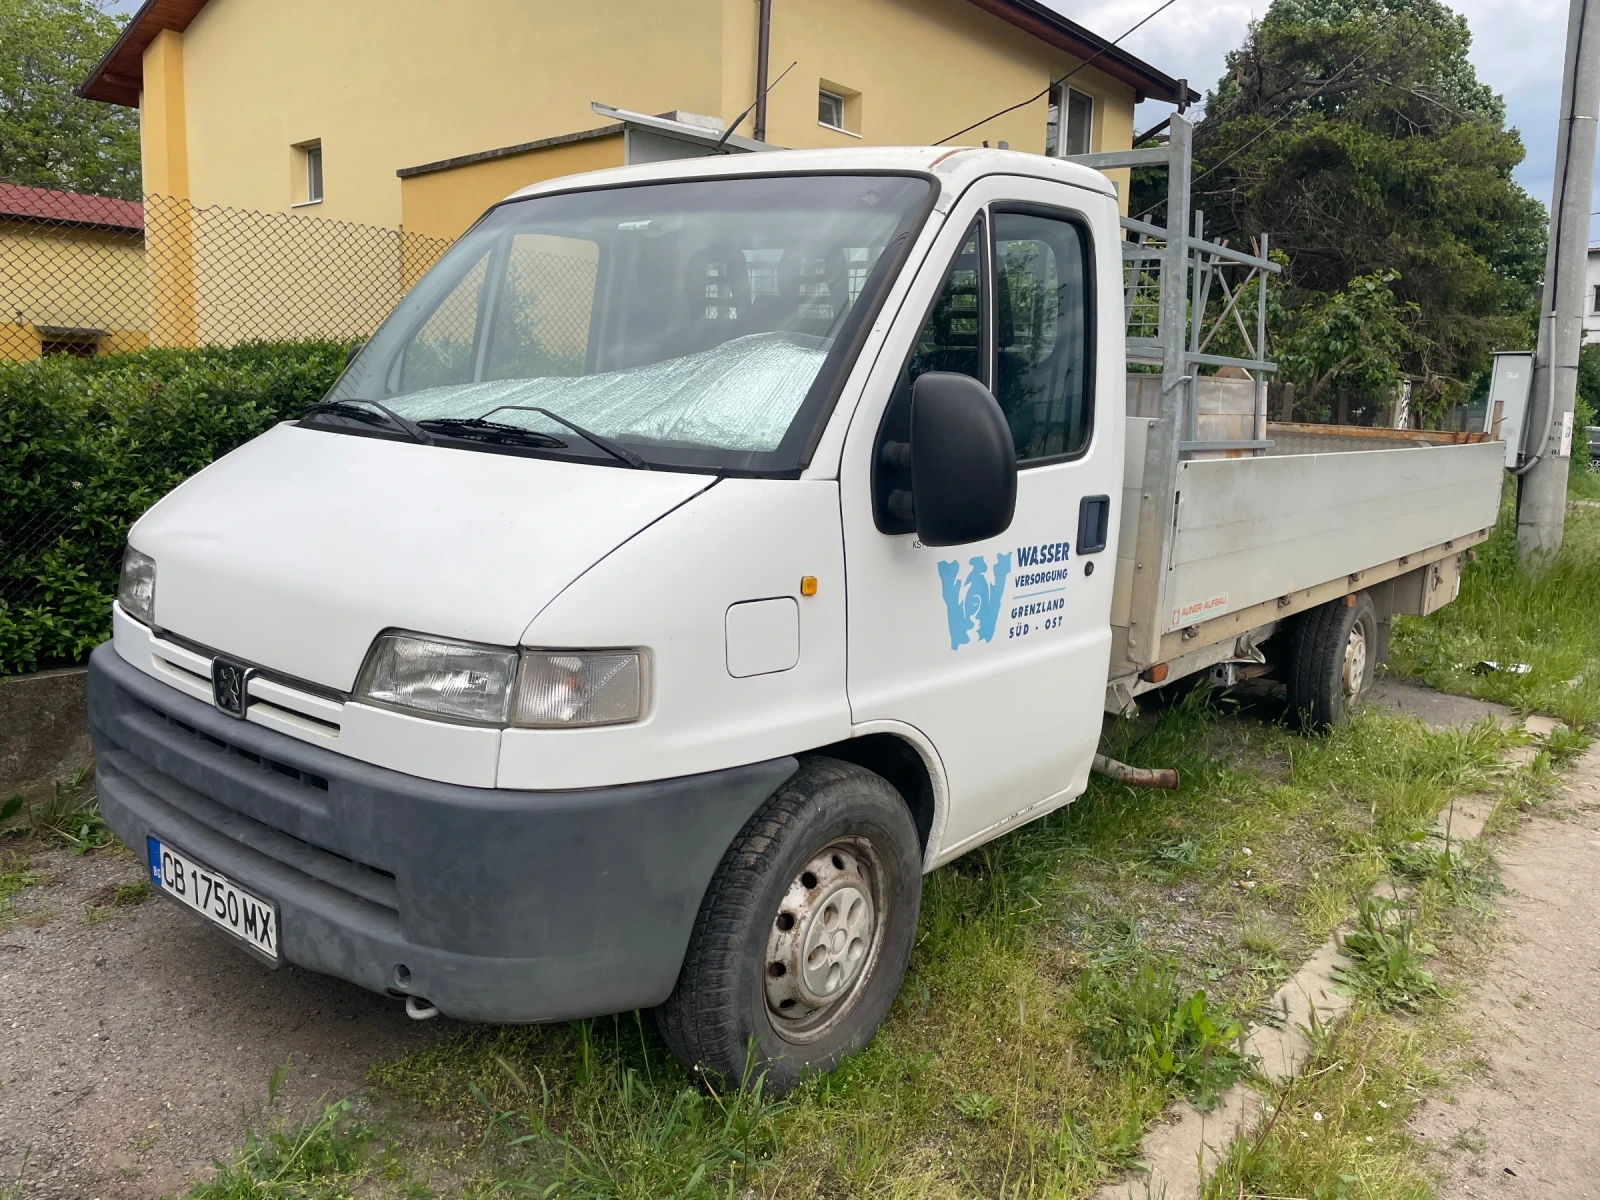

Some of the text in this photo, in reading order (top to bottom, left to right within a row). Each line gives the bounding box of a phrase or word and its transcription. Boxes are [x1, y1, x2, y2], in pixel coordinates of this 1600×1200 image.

[1017, 542, 1070, 567] WASSER
[1015, 568, 1068, 587] VERSORGUNG
[1011, 598, 1065, 619] GRENZLAND
[1009, 621, 1029, 639] SÜD
[1044, 616, 1063, 630] OST
[153, 866, 161, 879] BG
[162, 851, 273, 949] CB 1750 MX
